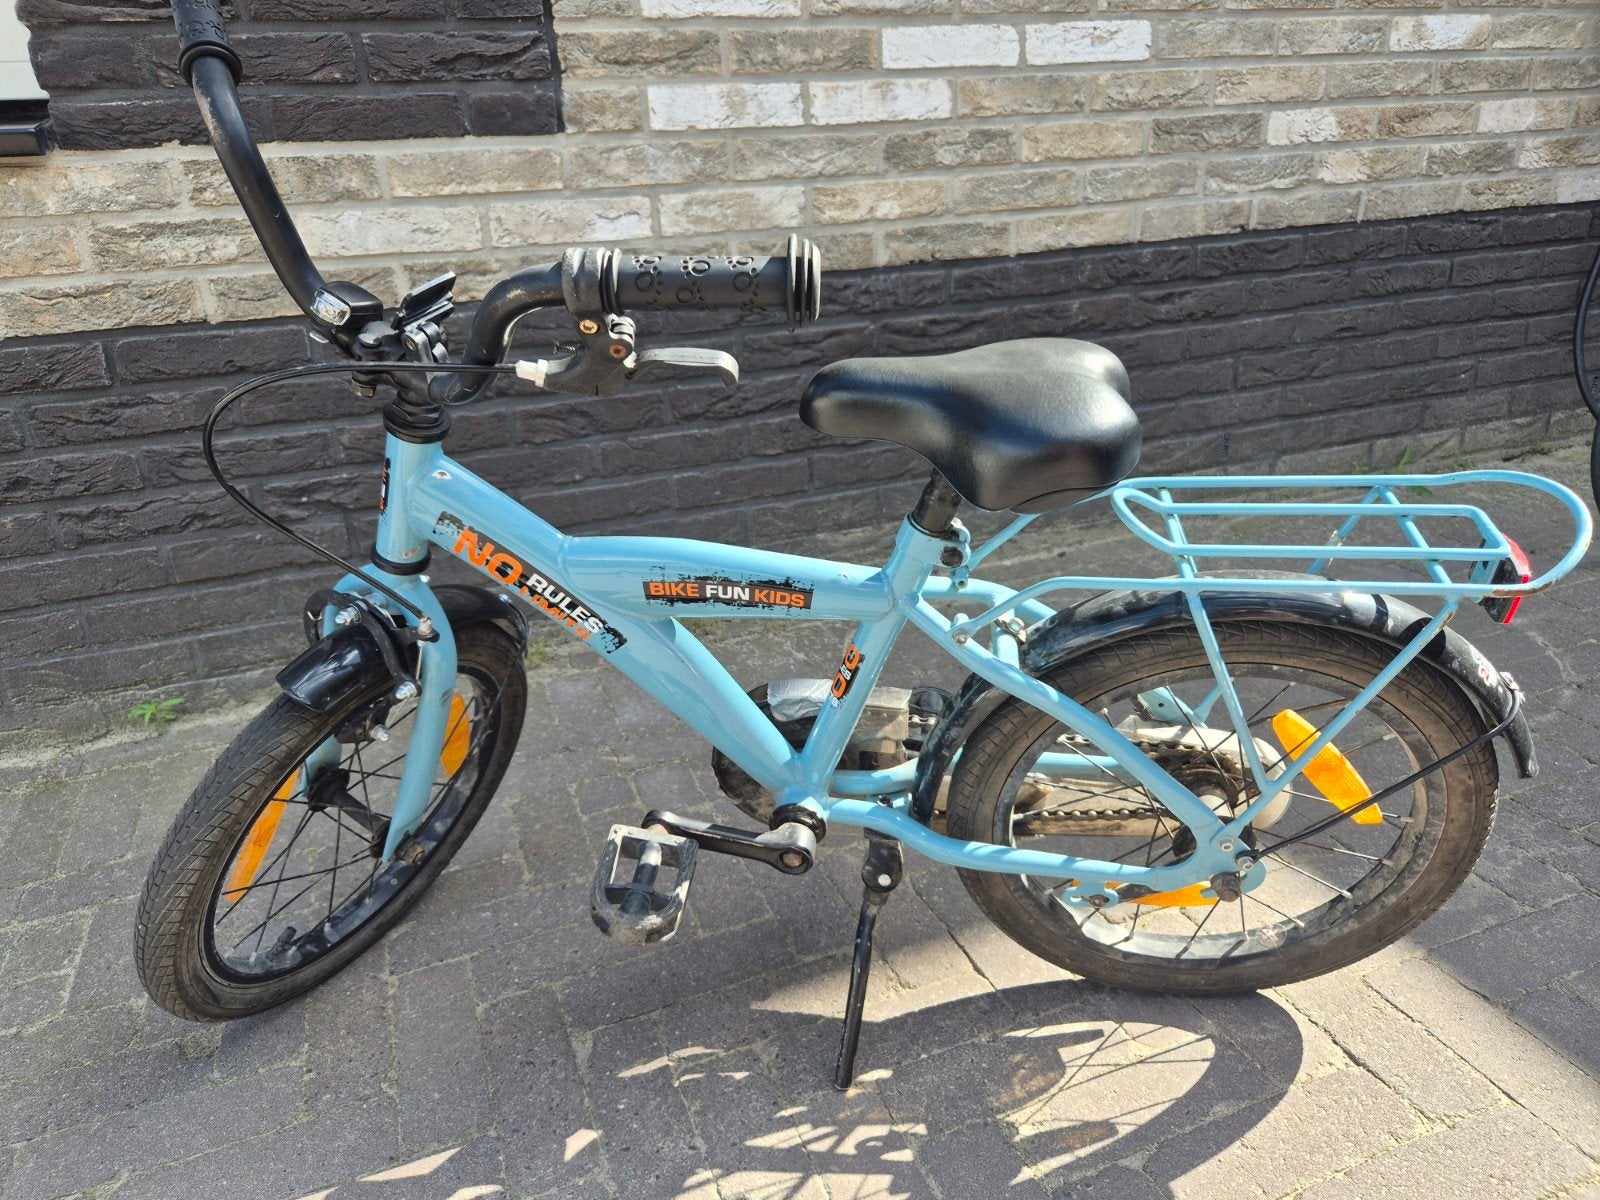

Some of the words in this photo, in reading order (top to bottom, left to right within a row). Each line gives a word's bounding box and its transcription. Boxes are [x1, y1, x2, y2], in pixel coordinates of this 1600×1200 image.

[453, 529, 523, 585] NO
[527, 573, 603, 634] RULES
[650, 582, 700, 597] BIKE
[705, 585, 749, 600] FUN
[754, 589, 805, 607] KIDS
